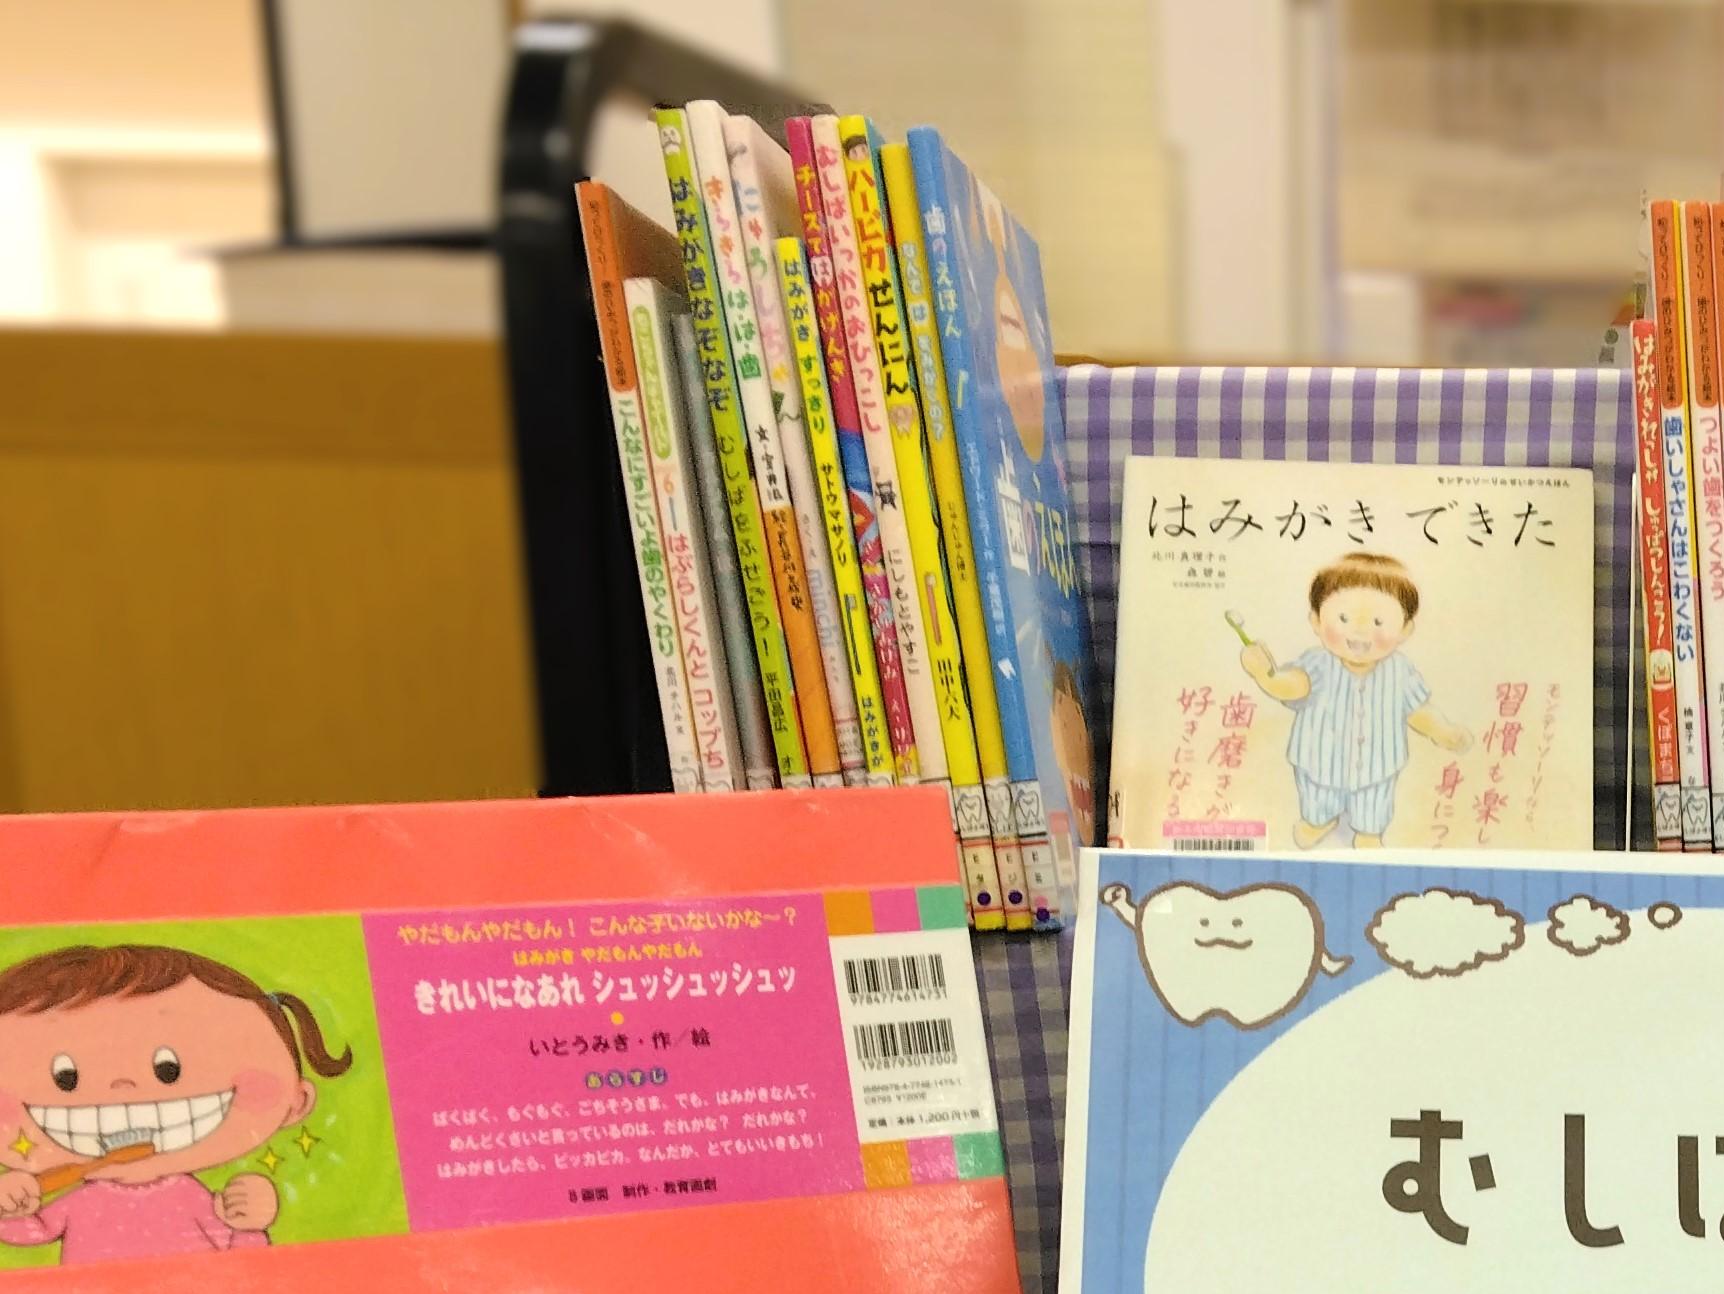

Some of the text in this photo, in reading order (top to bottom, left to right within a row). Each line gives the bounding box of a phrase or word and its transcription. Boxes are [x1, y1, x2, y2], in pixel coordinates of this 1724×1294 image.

[669, 176, 730, 413] はみがきなぞなぞ
[924, 203, 961, 338] 歯のえほん
[784, 259, 809, 342] はみがき
[800, 354, 825, 434] すっきり
[821, 462, 847, 568] サトウマサノリ
[1149, 493, 1557, 548] はみがきできた
[1664, 416, 1695, 662] 歯いしゃさんはこわくない
[888, 550, 920, 675] にしもとやすこ
[1168, 686, 1216, 817] 好きになる
[1207, 691, 1258, 820] 歯磨きが
[1657, 707, 1674, 777] くぼまち
[1431, 760, 1465, 850] 身につ
[413, 962, 797, 1015] きれいになあれ シュッシュッシュッ
[513, 949, 574, 967] はみがき
